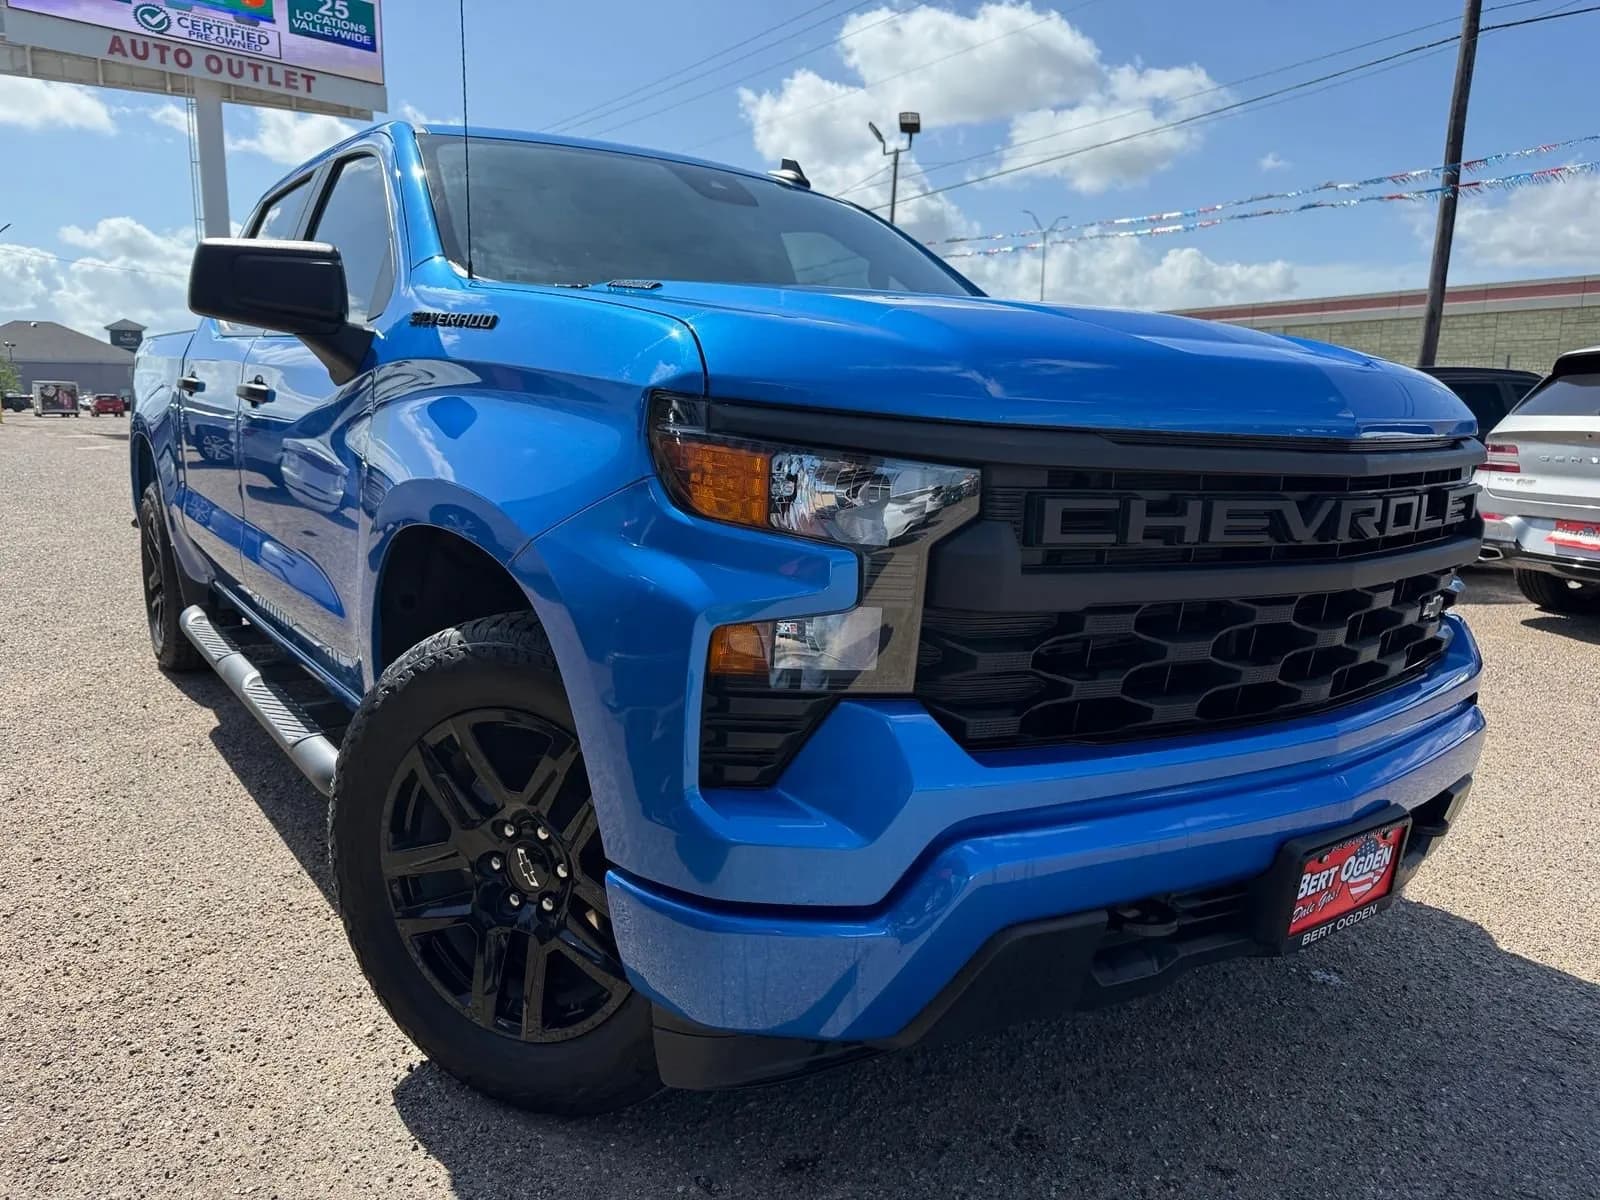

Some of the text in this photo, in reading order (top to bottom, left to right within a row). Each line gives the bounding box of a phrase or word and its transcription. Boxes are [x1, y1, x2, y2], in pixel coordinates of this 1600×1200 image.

[295, 9, 367, 34] LOCATIONS
[318, 0, 350, 19] 25
[177, 16, 270, 46] CERTIFIED
[188, 30, 263, 52] PRE-OWNED
[292, 18, 372, 45] VALLEYWIDE
[107, 35, 316, 93] AUTO OUTLET
[411, 312, 497, 329] SILVERADO
[1296, 845, 1393, 900] BERT OGDEN
[1302, 904, 1378, 946] BERT OGDEN
